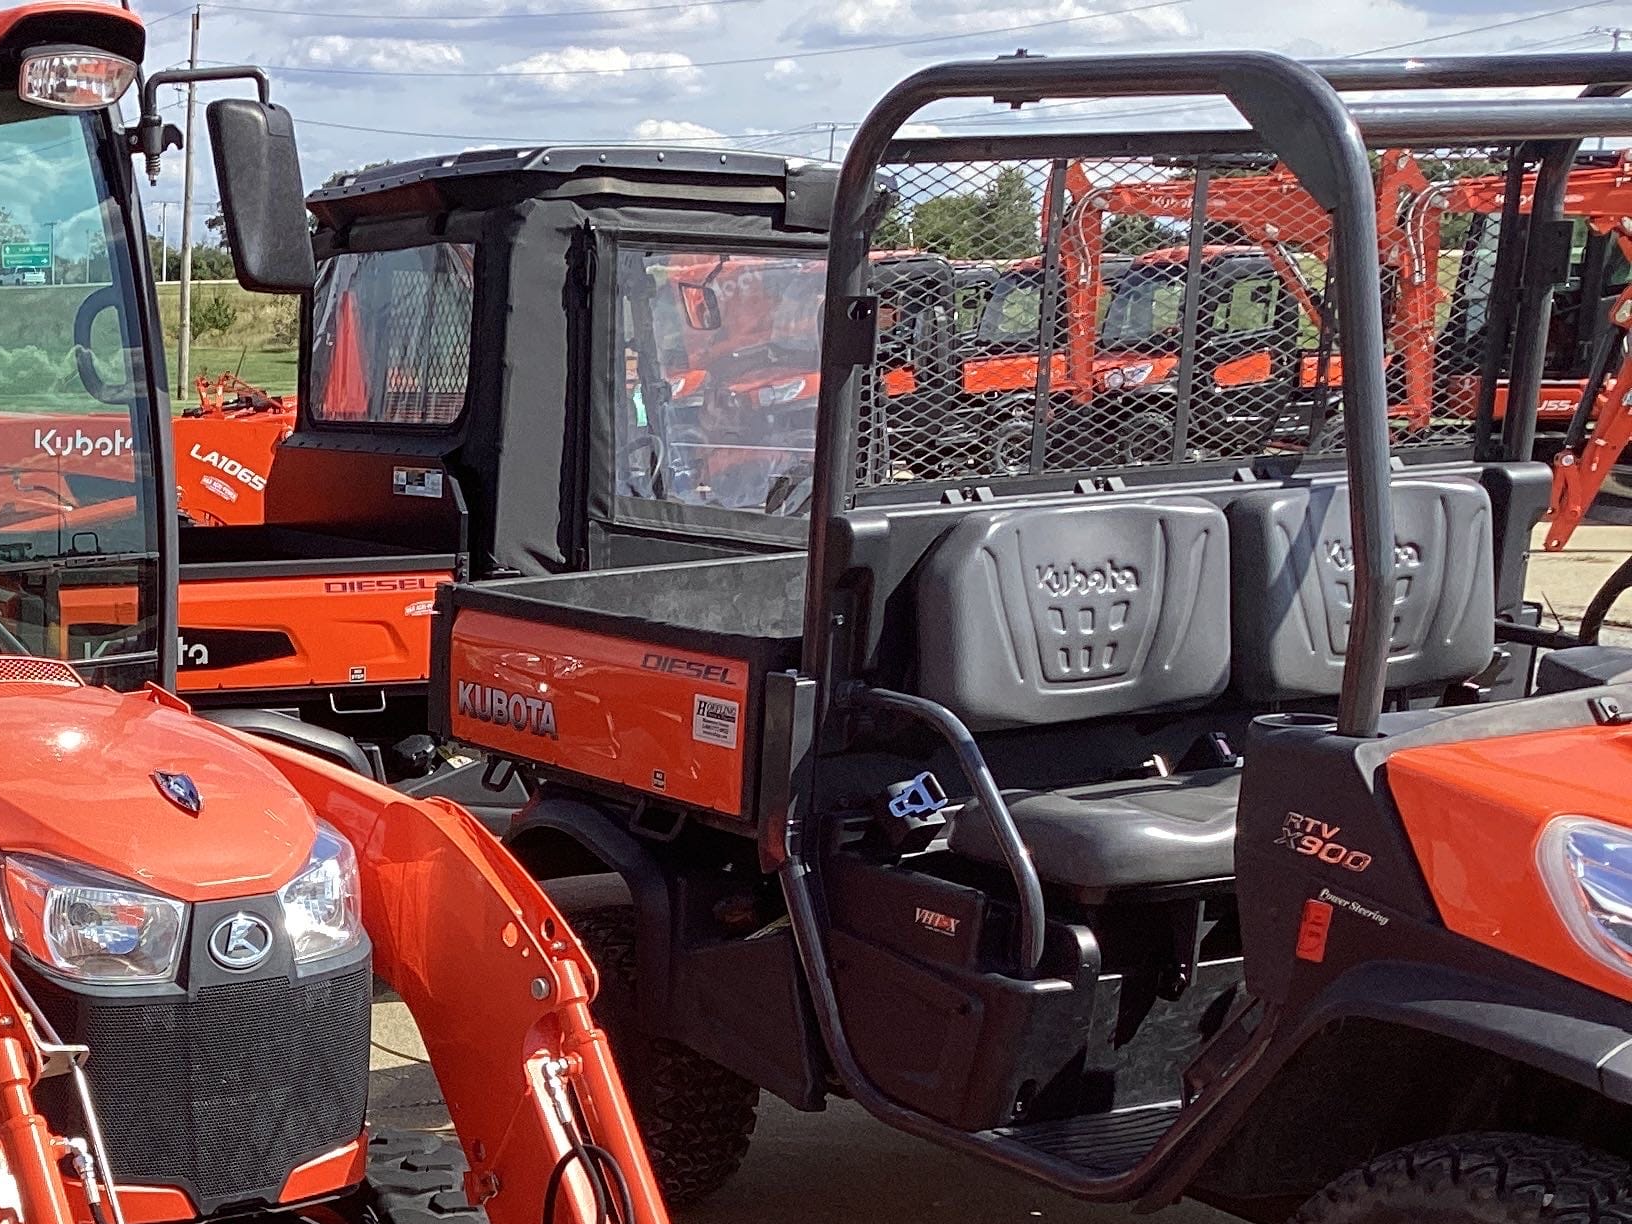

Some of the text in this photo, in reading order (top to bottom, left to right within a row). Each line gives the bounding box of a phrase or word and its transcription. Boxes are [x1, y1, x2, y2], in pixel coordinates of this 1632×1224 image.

[190, 443, 267, 491] LA1065
[325, 579, 436, 593] DIESEL
[1034, 559, 1140, 598] Kubota
[641, 654, 736, 685] DIESEL
[457, 680, 557, 737] KUBOTA
[1284, 811, 1340, 840] RTV
[1273, 827, 1372, 872] X900
[1319, 887, 1390, 926] Power Steering
